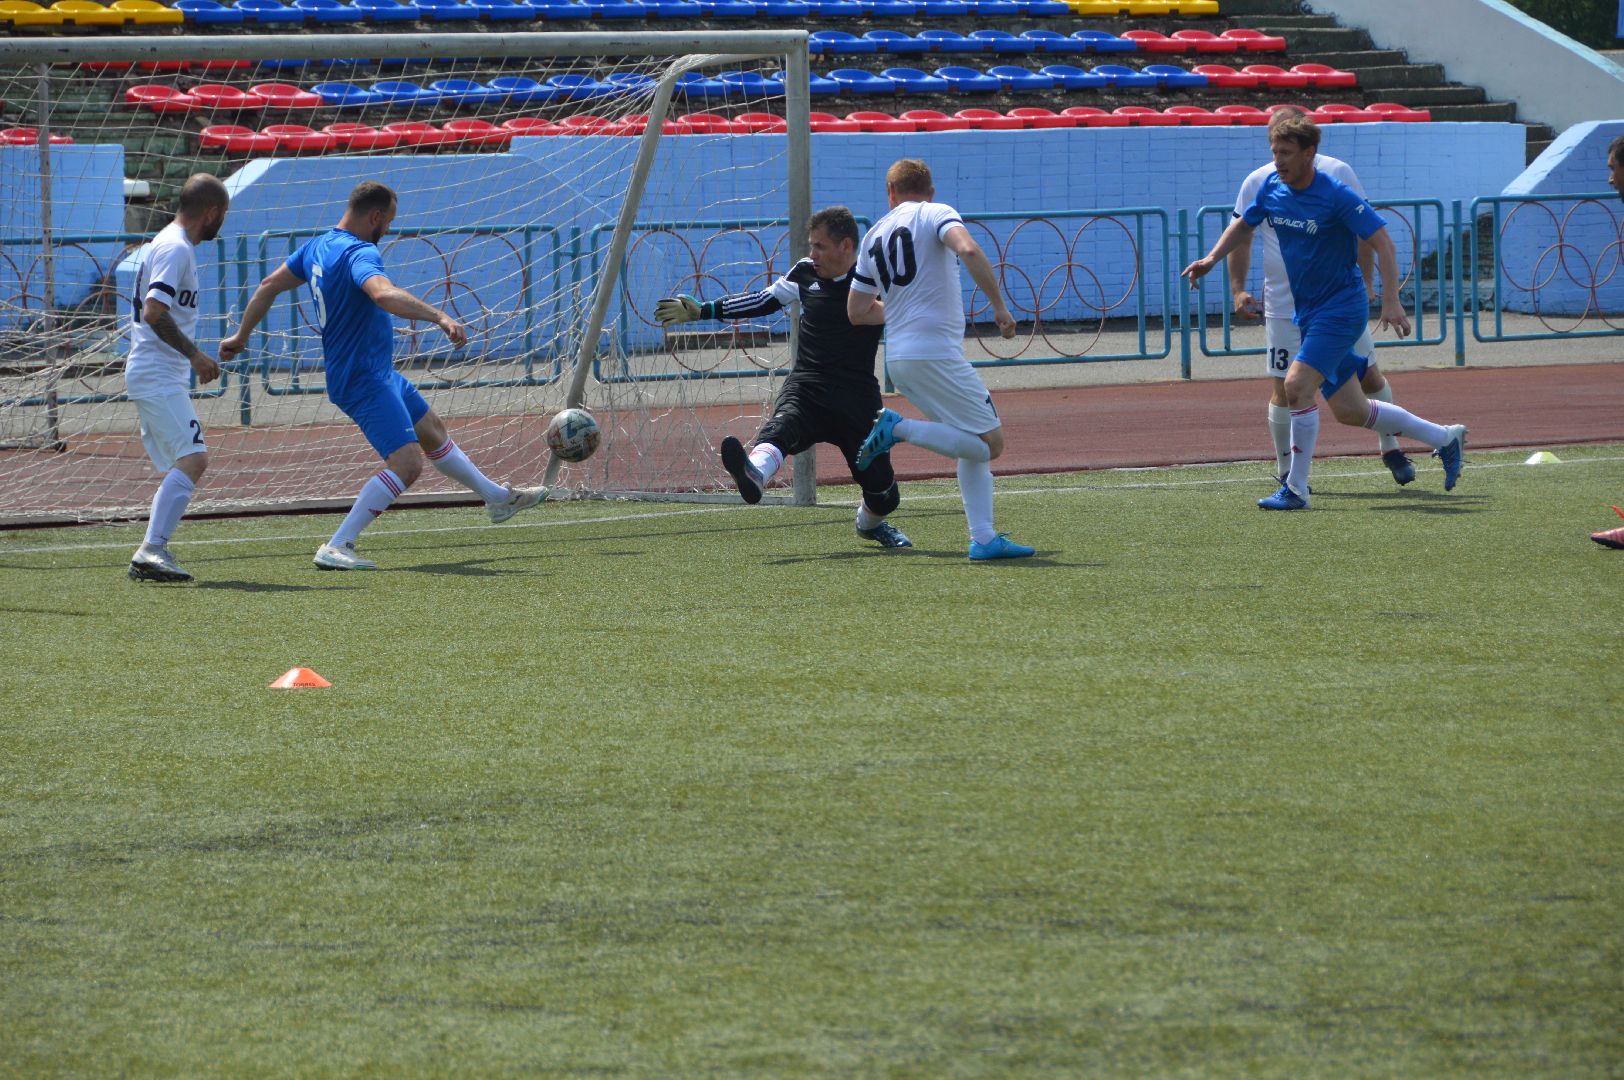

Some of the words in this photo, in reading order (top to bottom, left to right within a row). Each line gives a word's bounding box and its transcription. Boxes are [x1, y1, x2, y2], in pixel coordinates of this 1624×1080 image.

[868, 226, 917, 293] 10
[311, 263, 327, 328] 5
[1269, 346, 1289, 370] 13
[189, 419, 204, 444] 2
